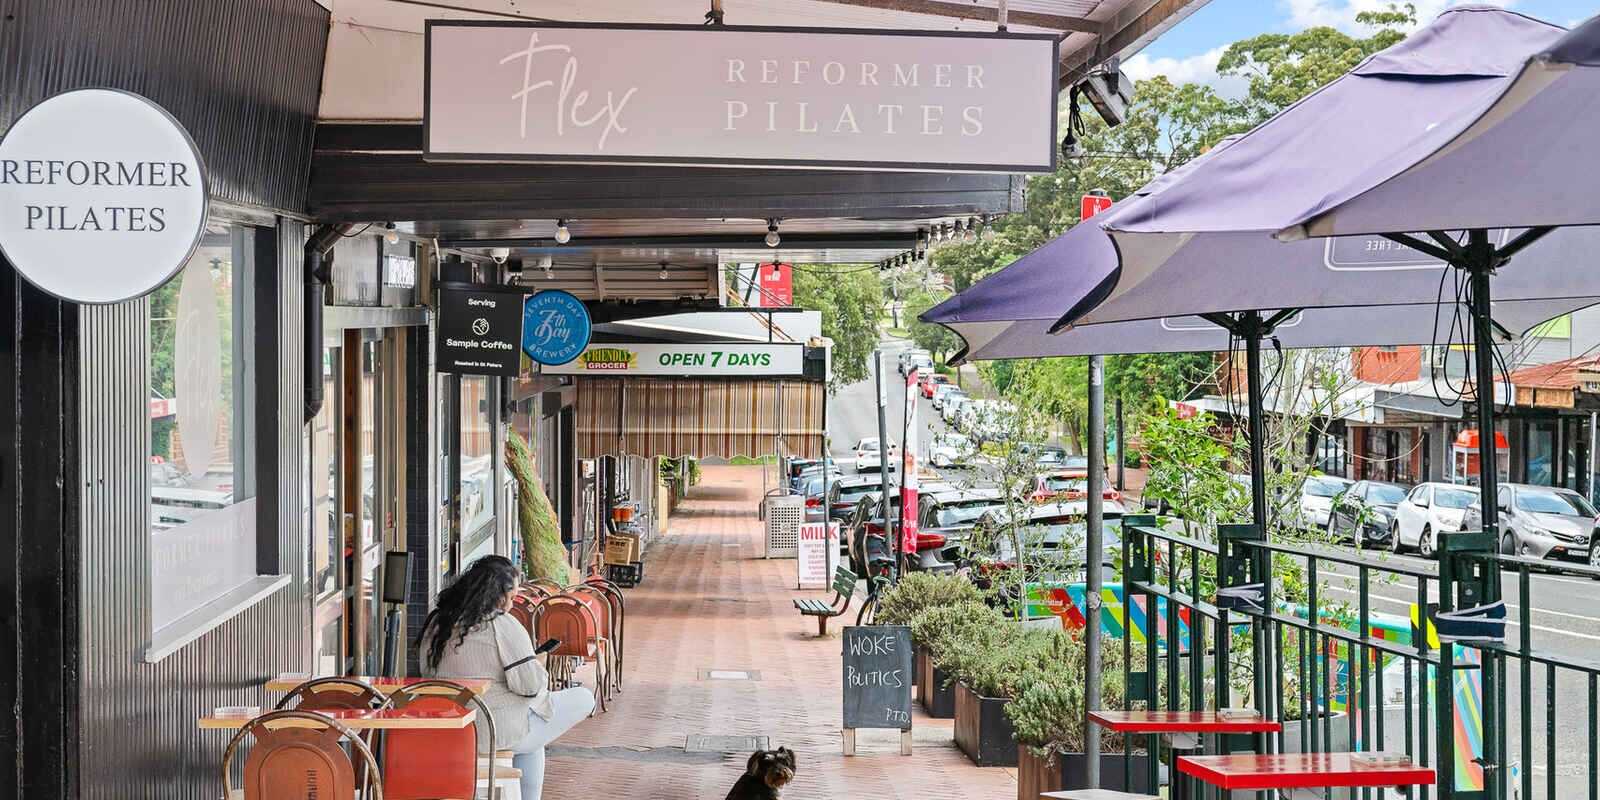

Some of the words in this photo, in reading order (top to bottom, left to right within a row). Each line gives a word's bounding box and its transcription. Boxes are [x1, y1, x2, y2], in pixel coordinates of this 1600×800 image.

[725, 58, 987, 90] REFORMER
[499, 31, 638, 150] Flex
[724, 100, 986, 137] PILATES
[1, 159, 191, 188] REFORMER
[24, 205, 167, 233] PILATES
[468, 298, 496, 308] Serving
[526, 296, 564, 318] SEVENTH
[446, 338, 479, 349] Sample
[480, 339, 513, 351] Coffee
[528, 343, 577, 359] BREWERY
[586, 348, 631, 363] FRIENDLY
[659, 352, 706, 366] OPEN
[710, 351, 724, 368] 7
[727, 353, 771, 367] DAYS
[587, 362, 626, 370] GROCER
[801, 526, 838, 540] MILK
[849, 633, 896, 657] WOKE
[847, 664, 903, 689] POLITICS
[886, 707, 911, 724] P.T.O.
